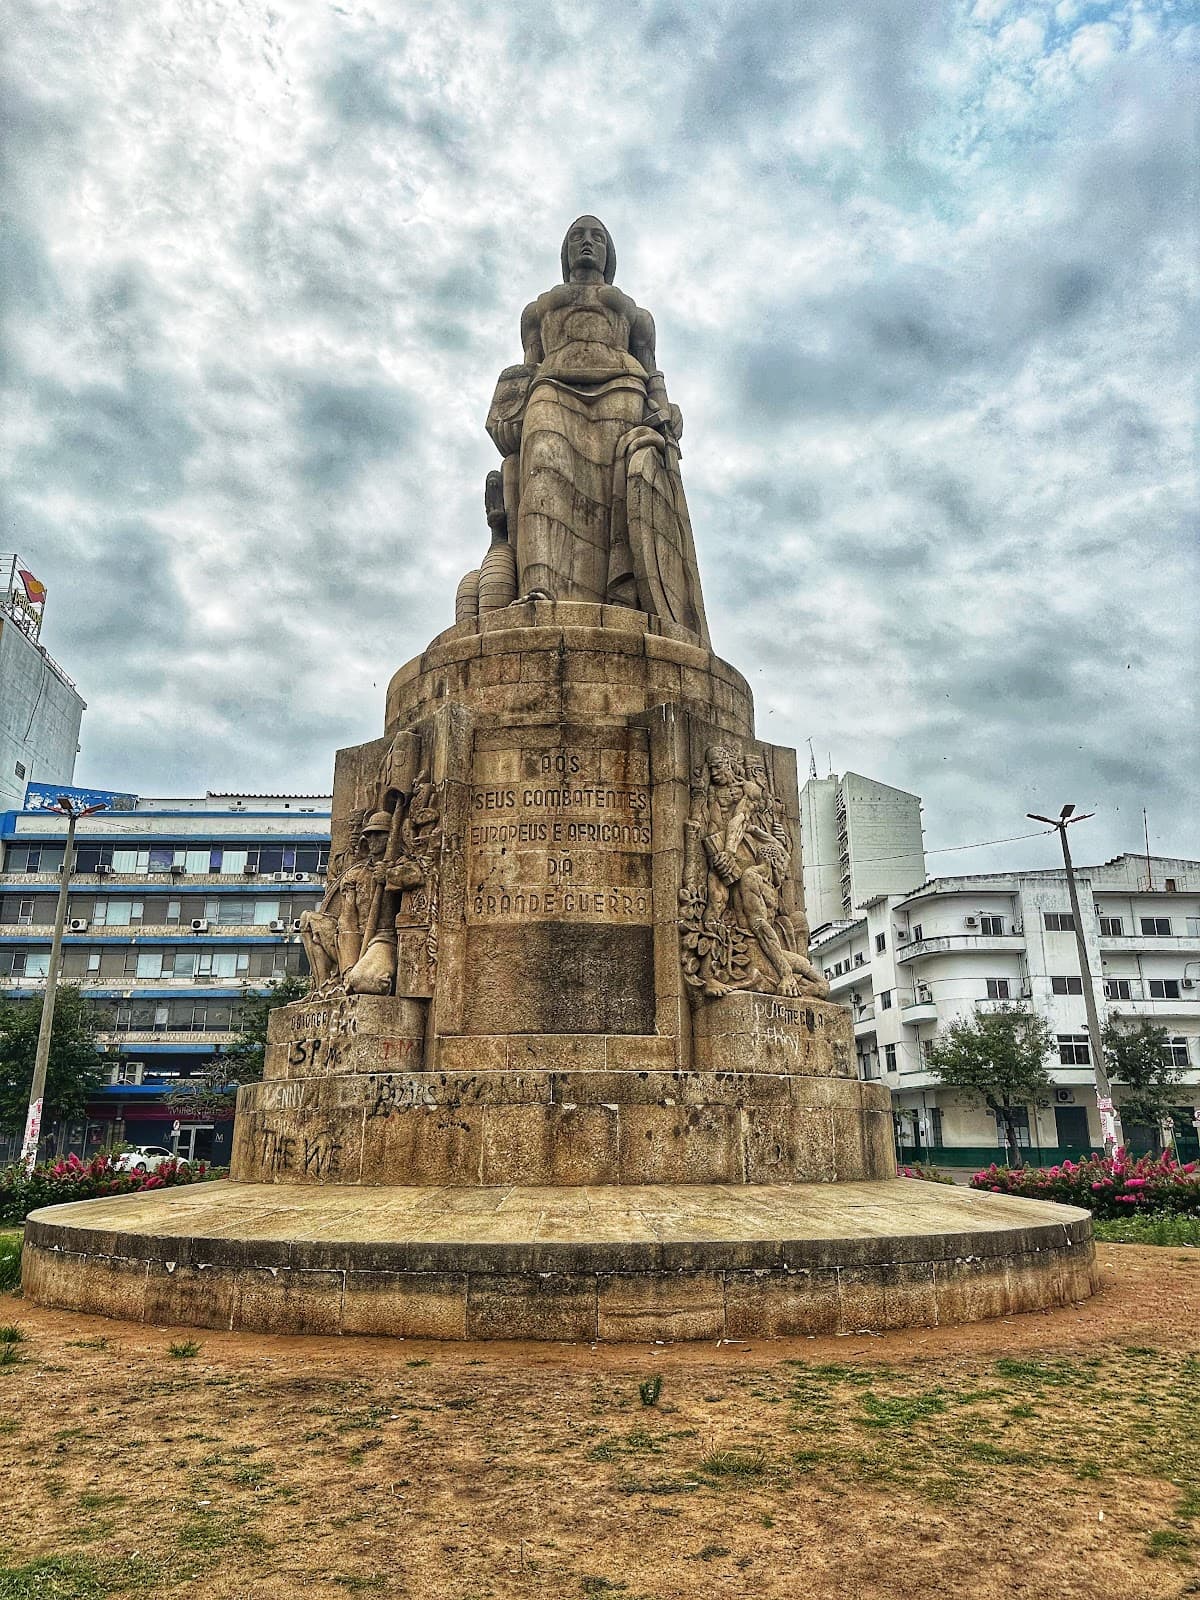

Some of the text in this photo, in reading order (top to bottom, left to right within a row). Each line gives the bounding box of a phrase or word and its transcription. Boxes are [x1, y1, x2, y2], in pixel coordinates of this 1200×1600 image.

[540, 755, 581, 774] AOS
[475, 789, 647, 810] SEUS COMBATENTES
[469, 823, 650, 846] EUROPEUS E AFRICANOS
[547, 857, 573, 877] DA
[473, 894, 647, 915] GRANDE GUERRA
